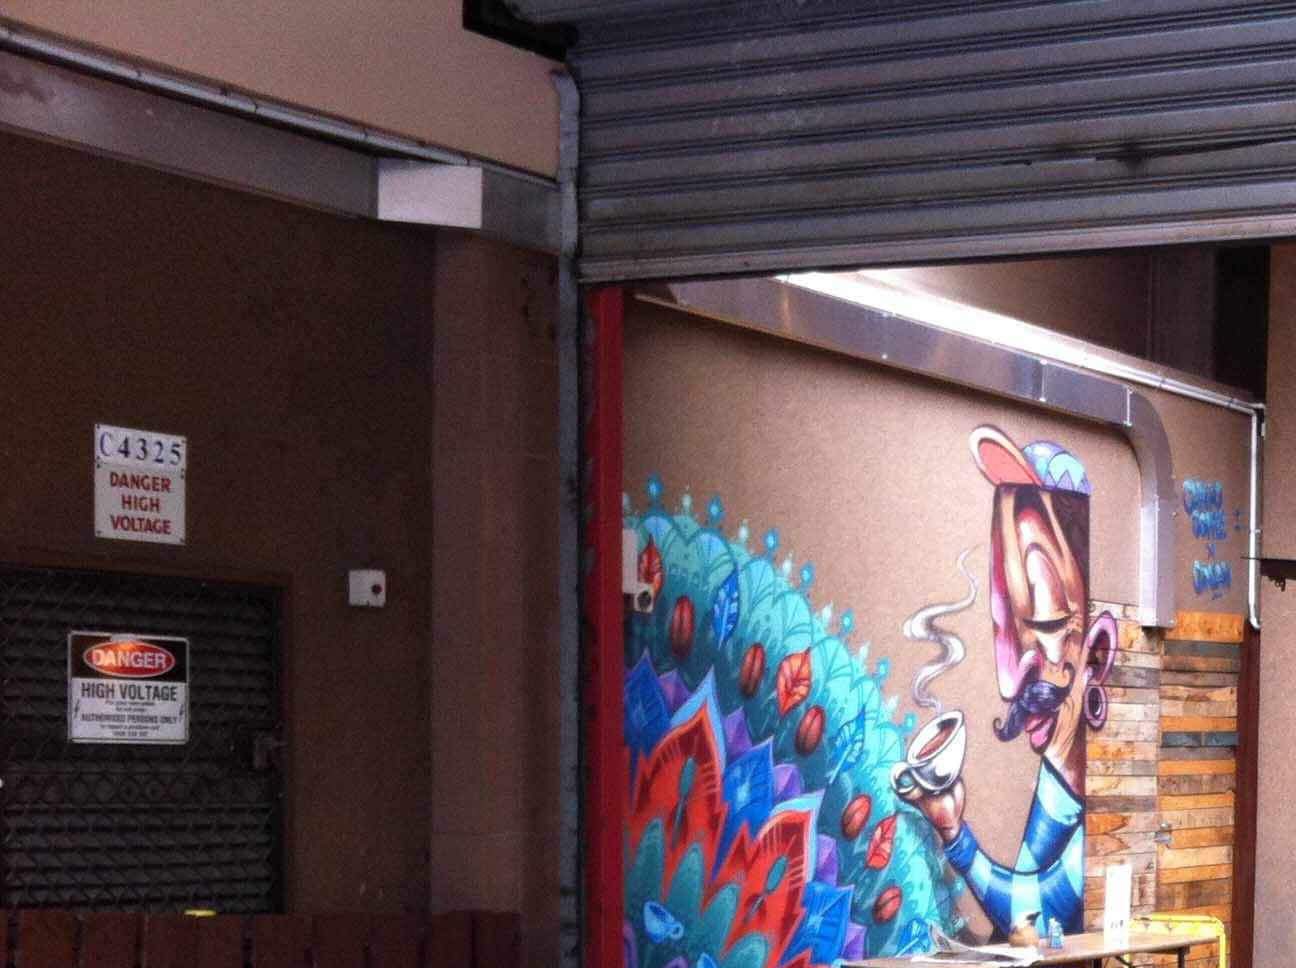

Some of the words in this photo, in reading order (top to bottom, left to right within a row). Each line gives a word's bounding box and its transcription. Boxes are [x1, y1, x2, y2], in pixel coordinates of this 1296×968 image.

[100, 431, 181, 466] C4325
[110, 471, 172, 493] DANGER
[121, 494, 161, 512] HIGH
[110, 514, 172, 535] VOLTAGE
[91, 649, 167, 669] DANGER
[81, 682, 115, 699] HIGH
[119, 684, 177, 701] VOLTAGE
